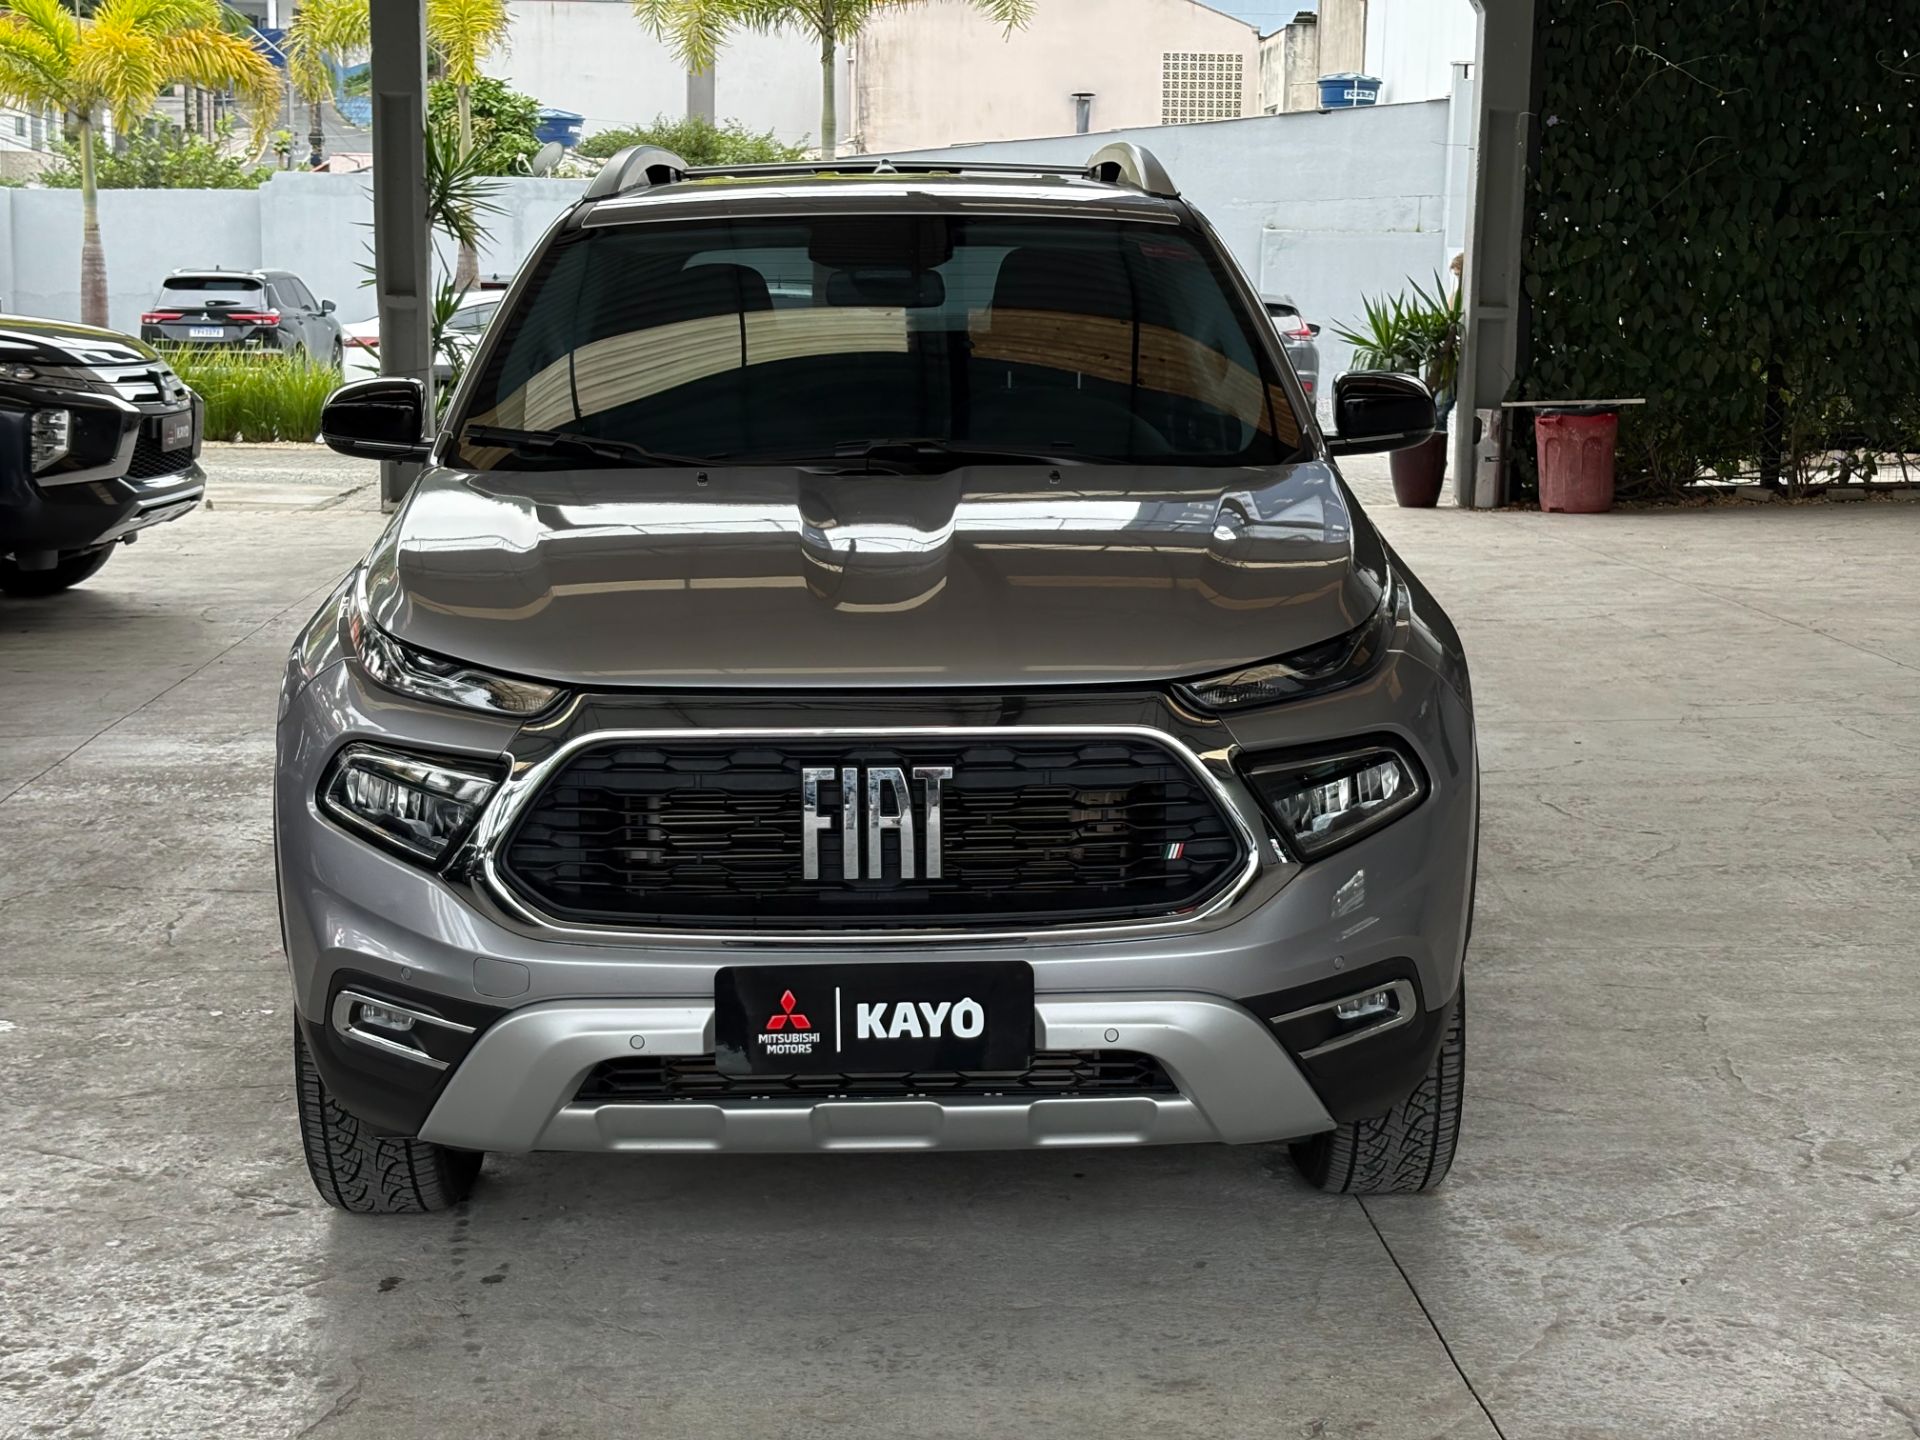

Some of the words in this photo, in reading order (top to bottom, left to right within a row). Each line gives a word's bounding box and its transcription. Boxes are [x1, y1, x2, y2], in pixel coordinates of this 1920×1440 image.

[802, 767, 953, 880] FIAT
[856, 996, 985, 1039] KAYÔ
[758, 1032, 820, 1044] MITSUBISHI
[766, 1043, 813, 1055] MOTORS
